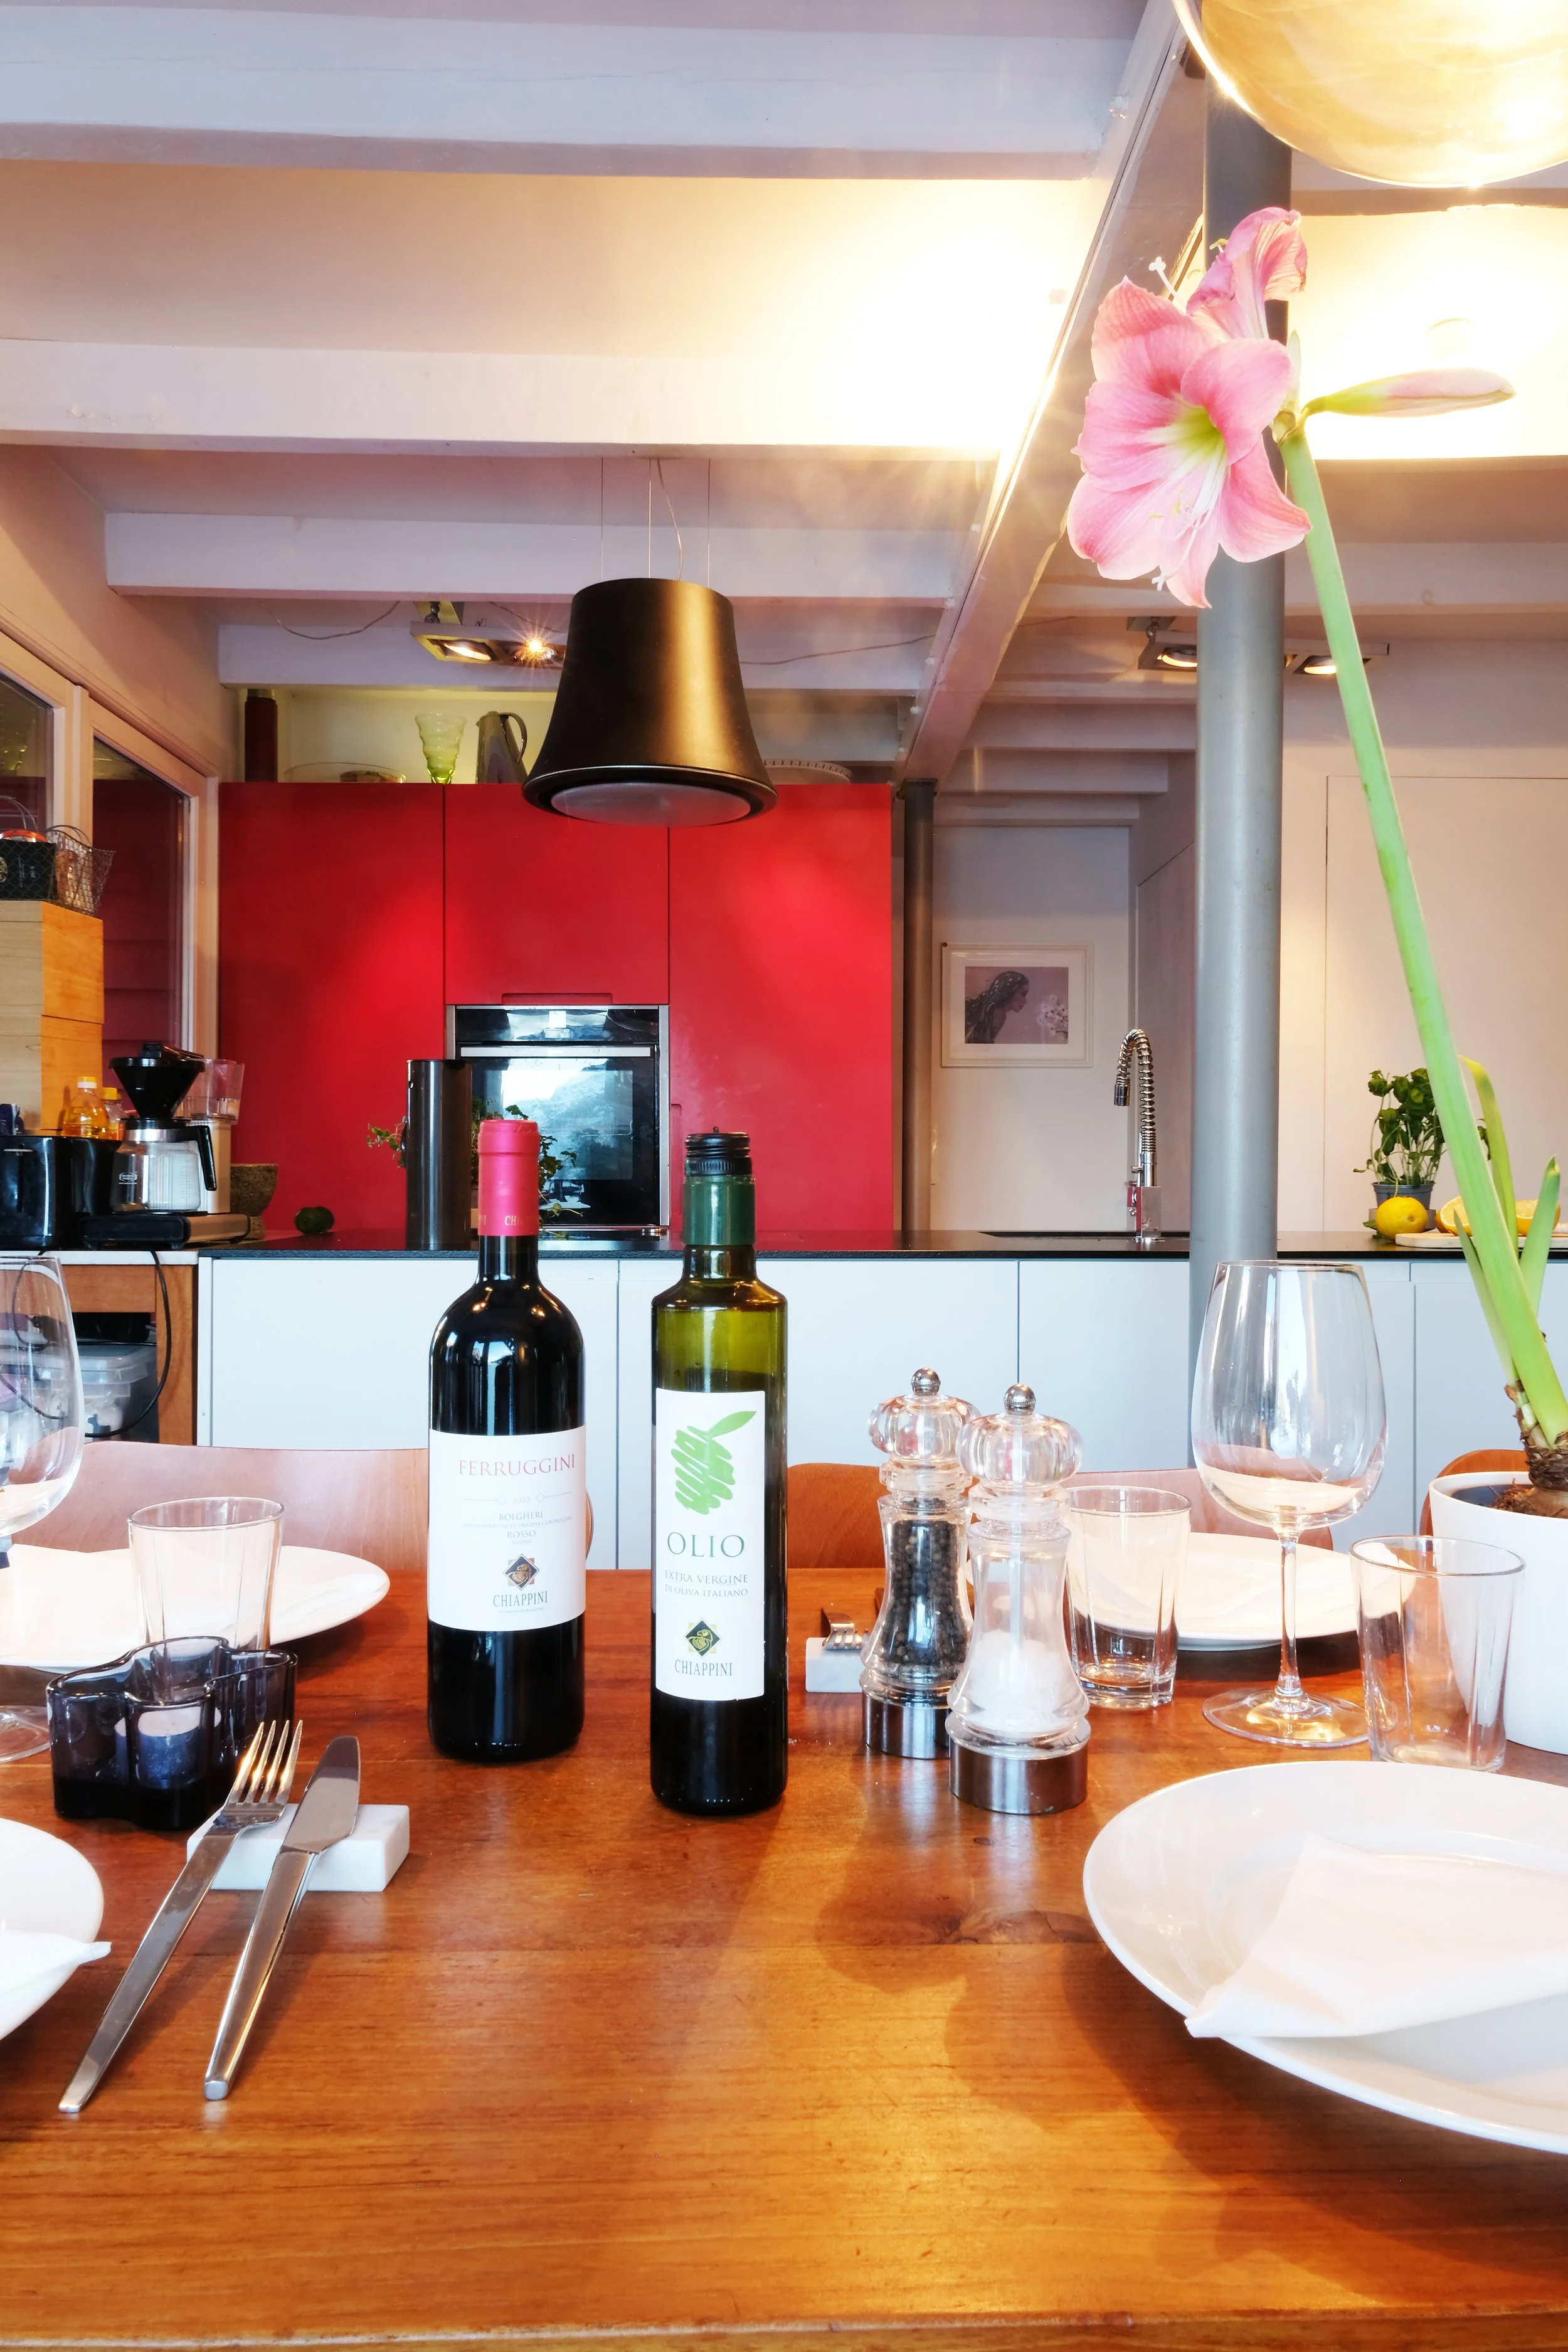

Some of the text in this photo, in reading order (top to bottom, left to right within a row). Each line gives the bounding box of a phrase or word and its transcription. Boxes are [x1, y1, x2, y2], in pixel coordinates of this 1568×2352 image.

[459, 1454, 575, 1476] FERRUGGINI
[499, 1510, 544, 1521] BOLGHERI
[507, 1530, 536, 1539] ROSSO
[667, 1532, 744, 1558] OLIO
[665, 1570, 748, 1584] EXTRA VERGINE
[665, 1584, 748, 1597] DI OLIVA ITALIANO
[493, 1591, 548, 1607] CHIAPPINI
[675, 1659, 733, 1676] CHIAPPINI
